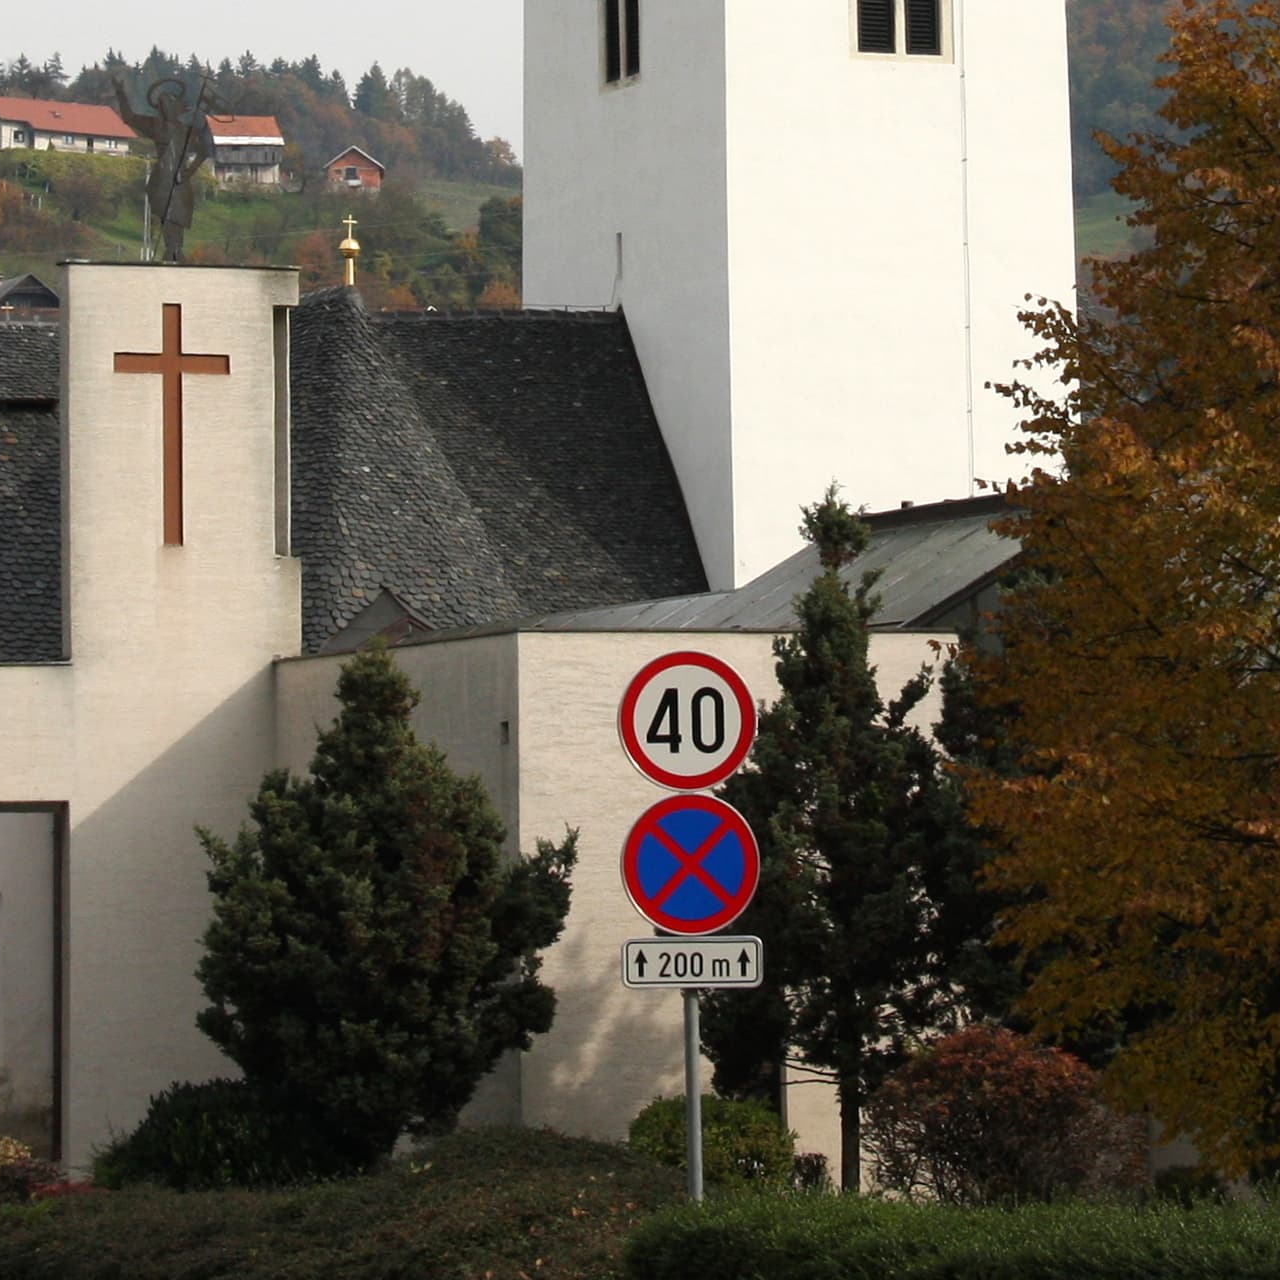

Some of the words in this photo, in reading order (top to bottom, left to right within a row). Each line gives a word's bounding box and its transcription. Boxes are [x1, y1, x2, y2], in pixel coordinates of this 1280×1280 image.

[646, 687, 725, 754] 40
[658, 952, 704, 978] 200
[712, 958, 730, 977] m
